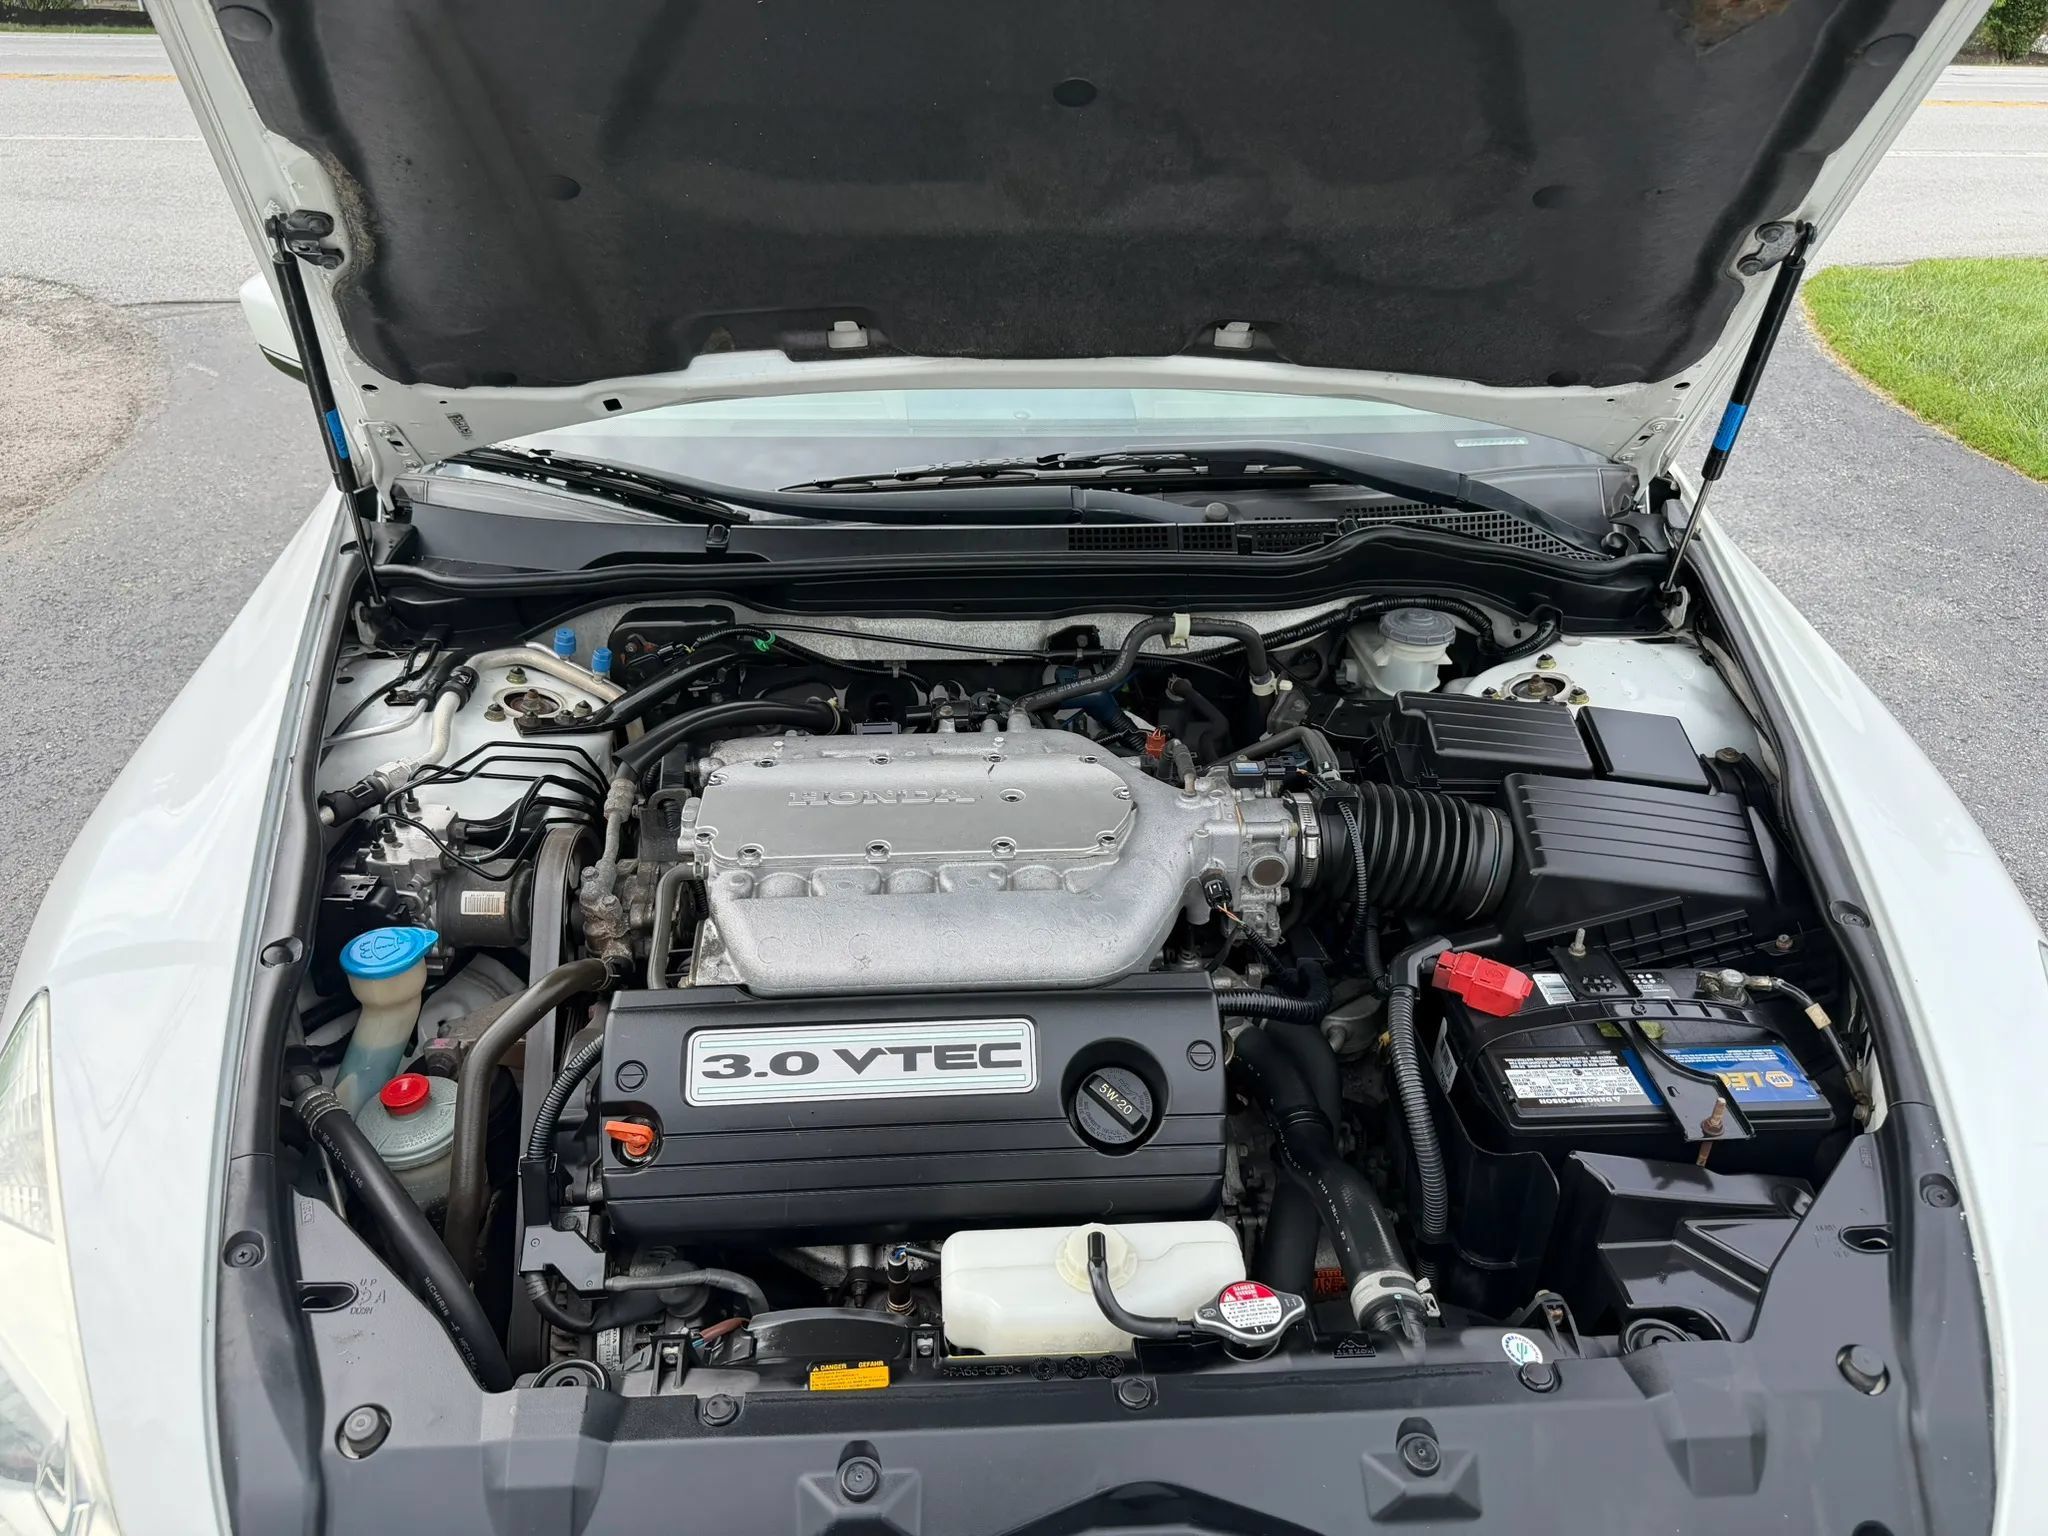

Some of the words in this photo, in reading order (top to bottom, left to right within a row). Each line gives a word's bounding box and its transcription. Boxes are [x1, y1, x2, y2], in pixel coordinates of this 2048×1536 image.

[788, 789, 976, 806] HONDA
[702, 1051, 820, 1080] 3.0
[832, 1042, 1023, 1076] VTEC
[1099, 1083, 1133, 1115] 5W-20
[820, 1363, 848, 1371] DANGER
